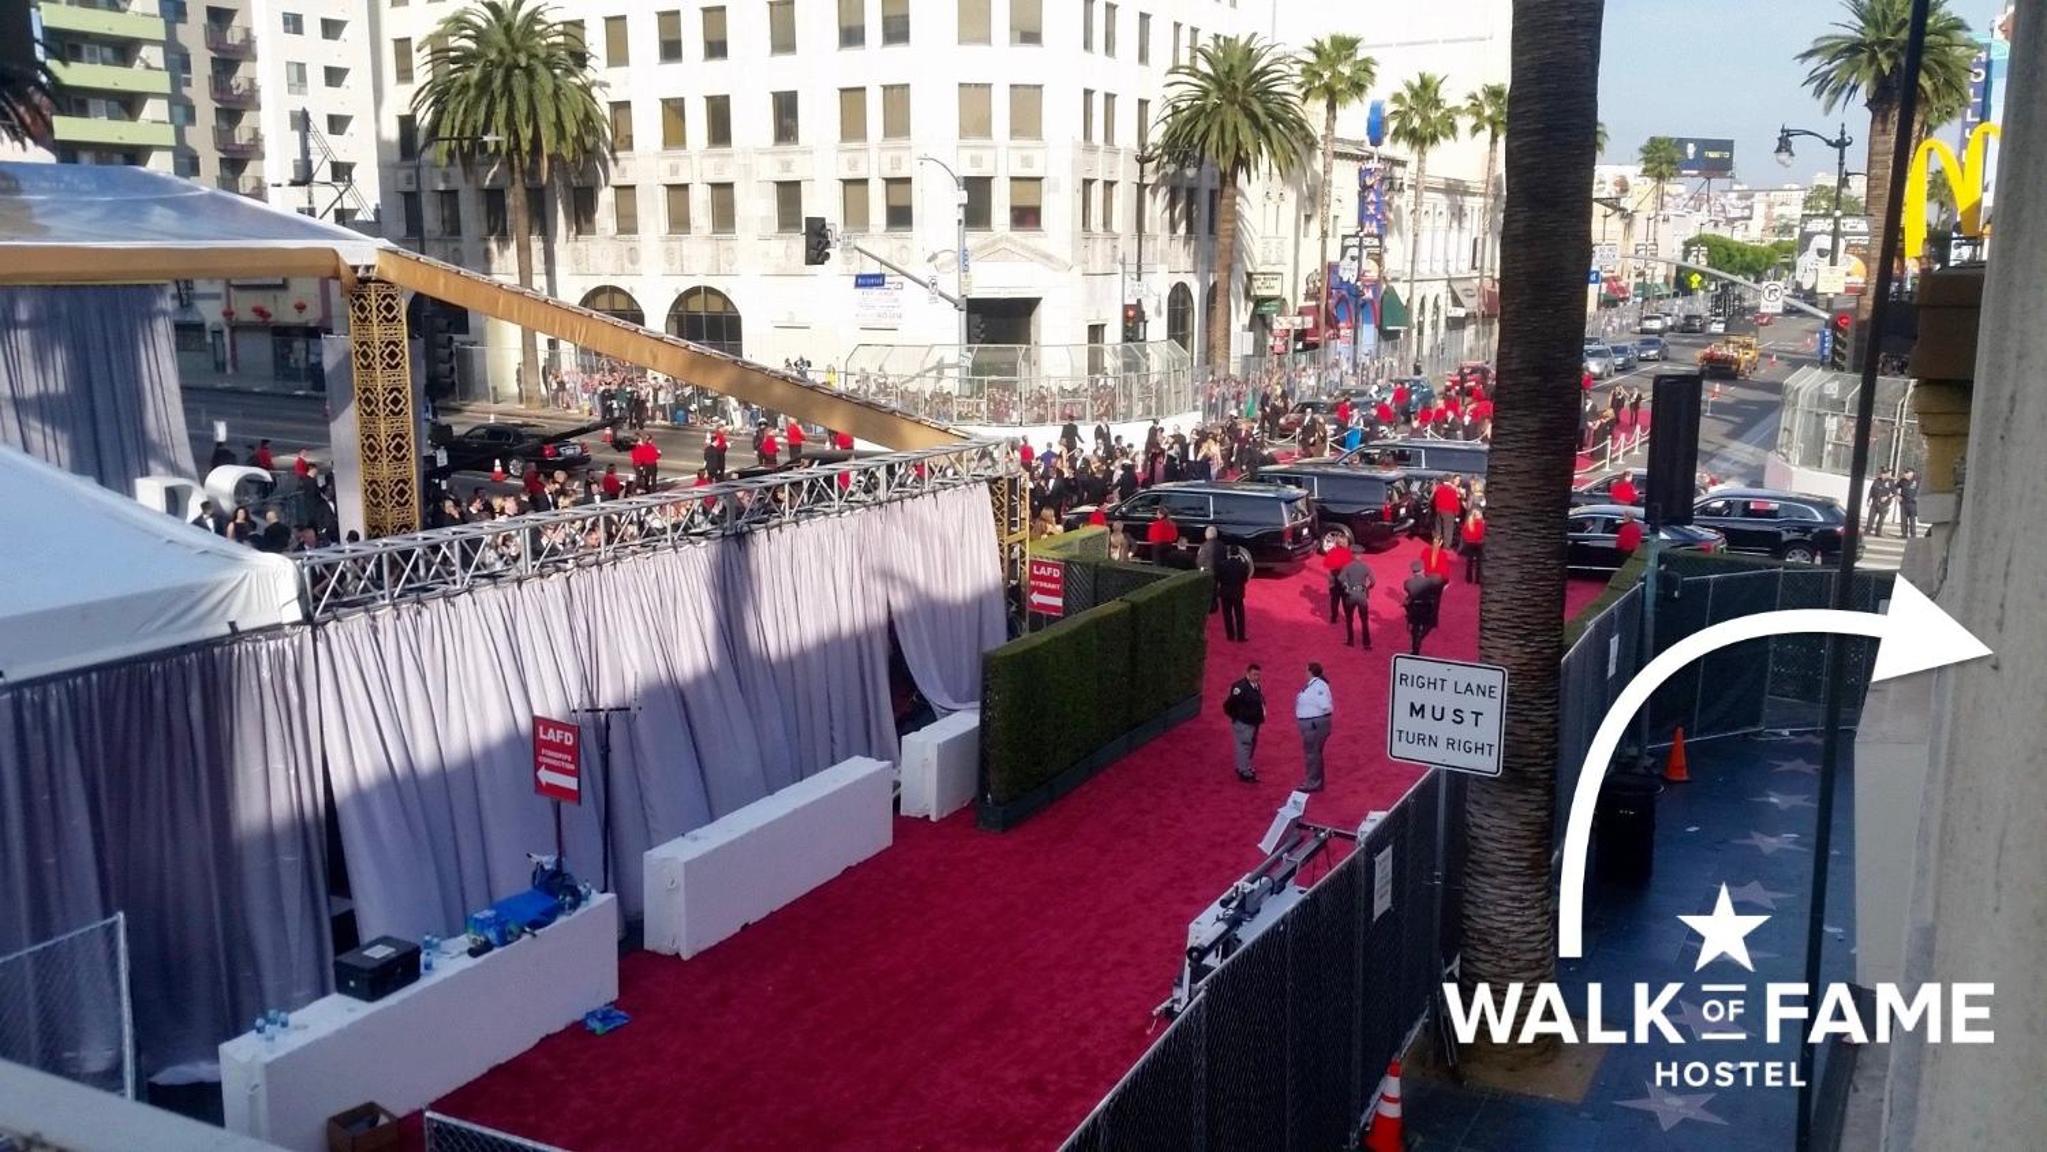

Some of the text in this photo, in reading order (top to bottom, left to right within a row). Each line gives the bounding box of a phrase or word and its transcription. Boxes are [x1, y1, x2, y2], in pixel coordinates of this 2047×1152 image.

[1034, 565, 1060, 578] LAFD
[1399, 673, 1498, 699] RIGHT LANE
[1410, 702, 1483, 727] MUST
[539, 725, 574, 745] LAFD
[1396, 729, 1495, 757] TURN RIGHT
